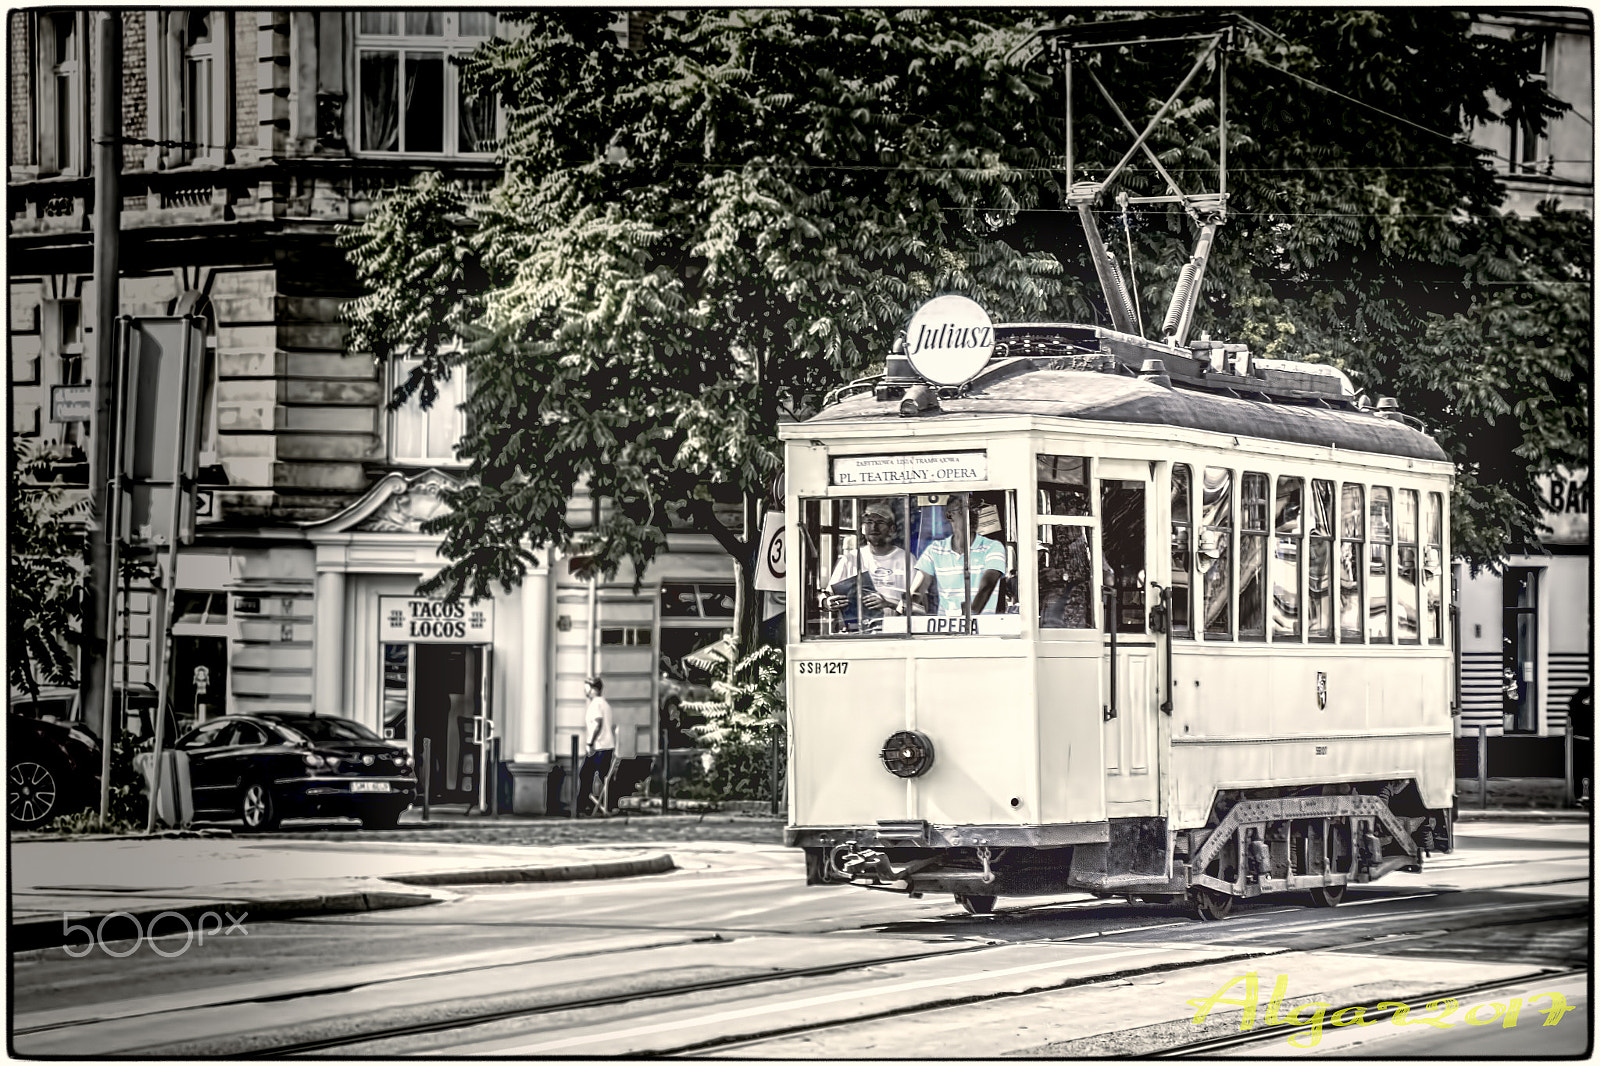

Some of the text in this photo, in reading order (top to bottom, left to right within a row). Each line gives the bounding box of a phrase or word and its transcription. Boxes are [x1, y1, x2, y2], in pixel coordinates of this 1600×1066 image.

[911, 323, 991, 355] Juliusz
[839, 473, 857, 483] PL.
[860, 470, 928, 482] TEATRALNY
[937, 469, 977, 479] OPERA
[408, 601, 465, 618] TACOS
[409, 621, 466, 638] LOCOS
[927, 618, 979, 635] OPERA
